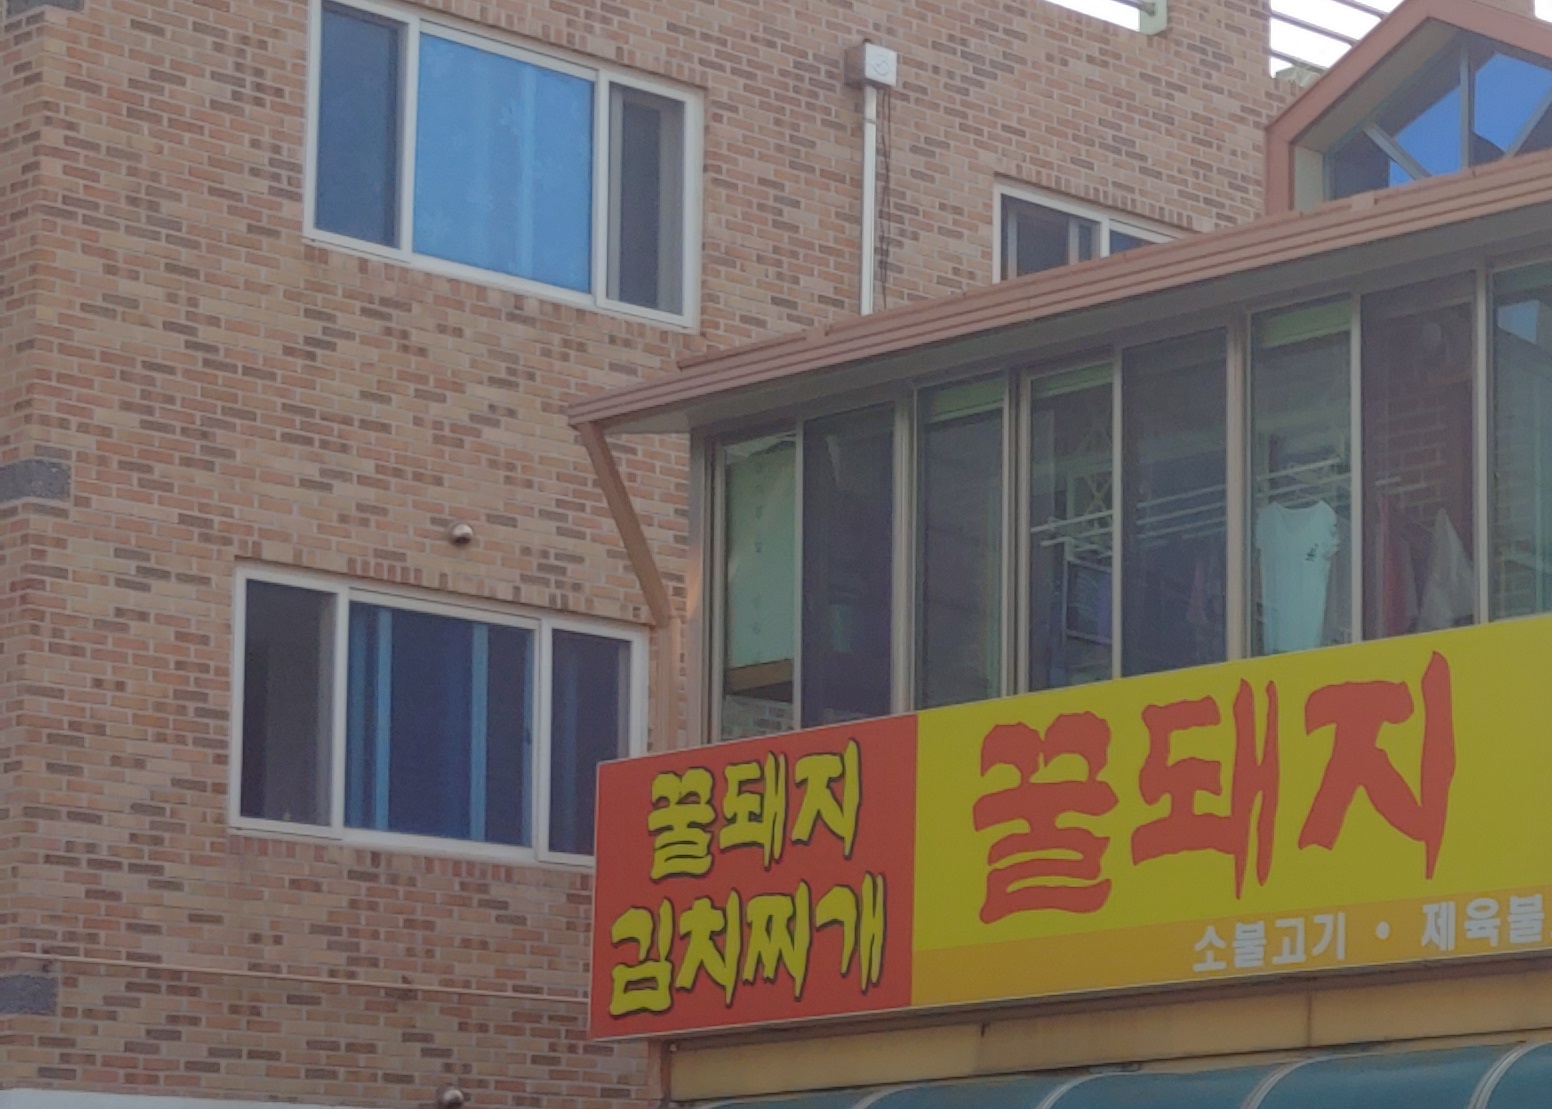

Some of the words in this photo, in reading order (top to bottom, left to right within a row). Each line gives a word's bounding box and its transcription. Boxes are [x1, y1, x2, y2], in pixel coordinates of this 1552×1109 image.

[645, 737, 862, 882] 꿀돼지
[972, 650, 1456, 925] 꿀돼지
[608, 871, 885, 1021] 김치찌개
[1192, 914, 1348, 974] 소불고기
